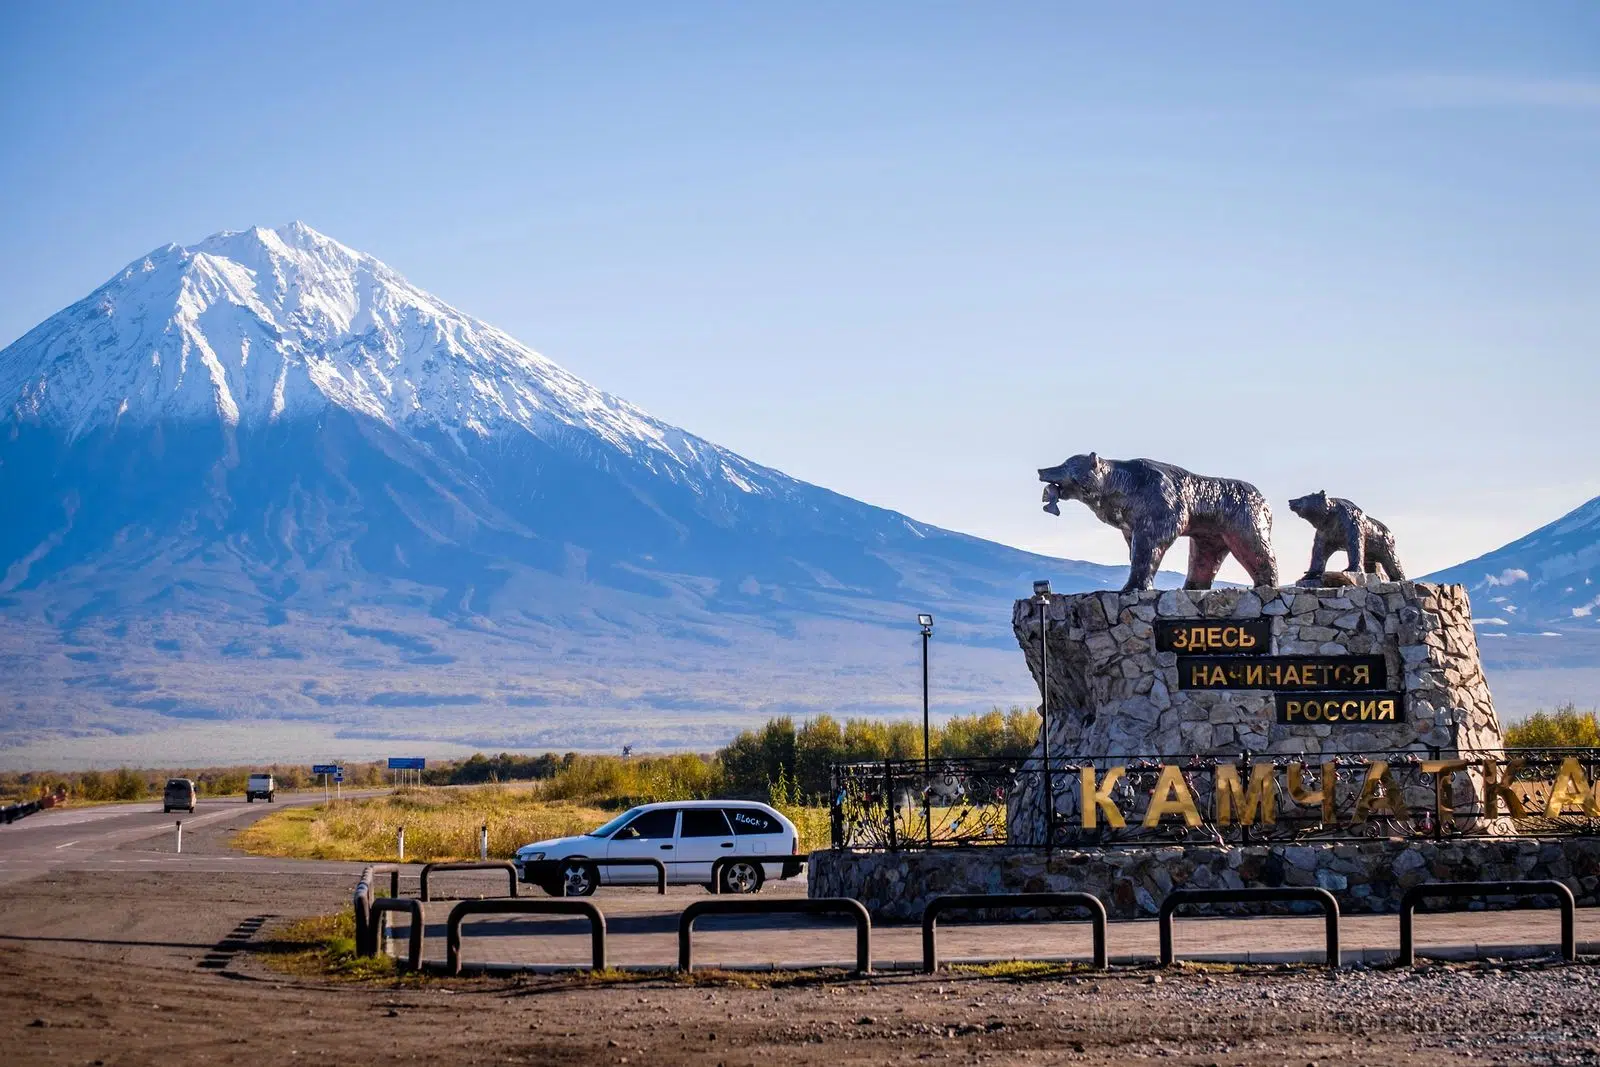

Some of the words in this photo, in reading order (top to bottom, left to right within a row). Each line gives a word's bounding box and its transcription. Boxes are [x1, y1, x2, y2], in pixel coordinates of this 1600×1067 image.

[1172, 627, 1256, 651] ЗДЕСЬ
[1191, 664, 1370, 686] НАЧИНАЕТСЯ
[1286, 700, 1395, 721] РОССИЯ
[1079, 757, 1600, 830] КАМЧАТКА
